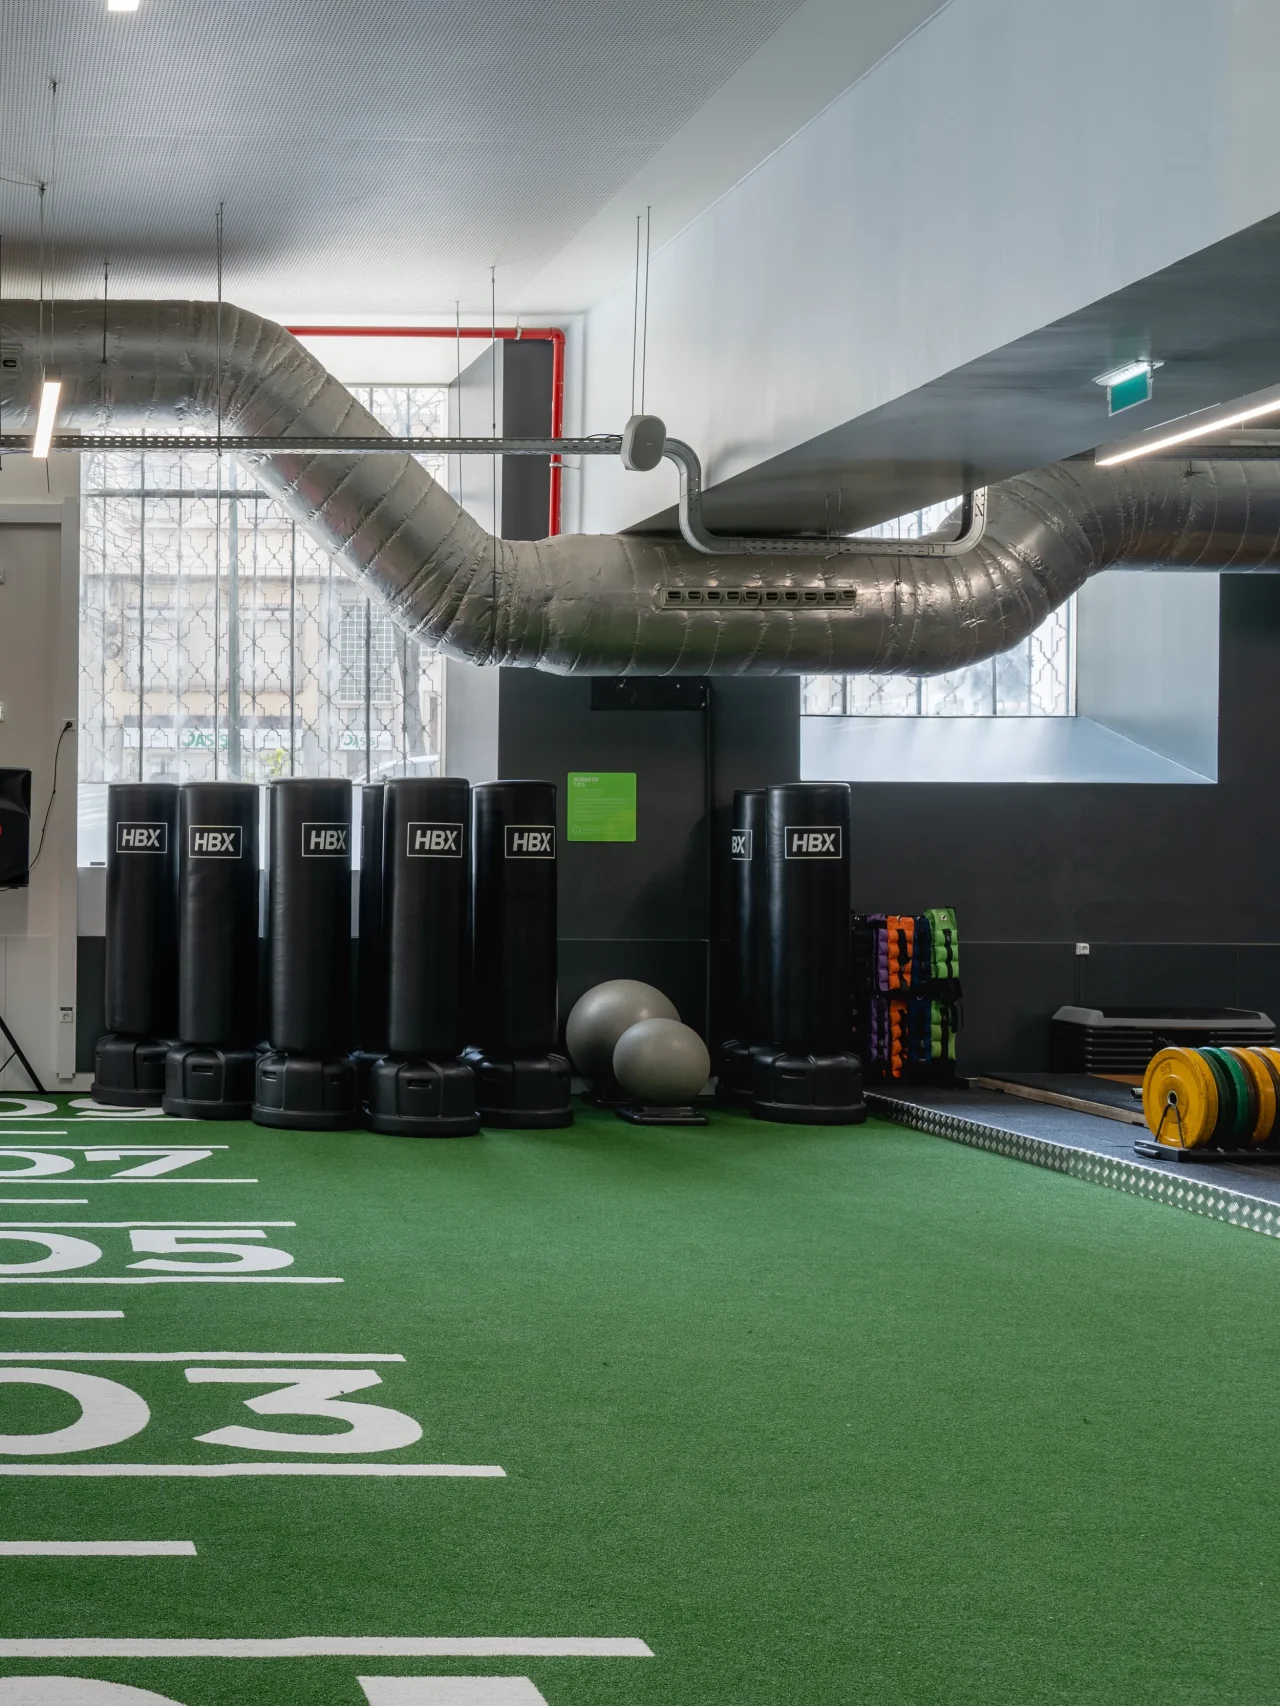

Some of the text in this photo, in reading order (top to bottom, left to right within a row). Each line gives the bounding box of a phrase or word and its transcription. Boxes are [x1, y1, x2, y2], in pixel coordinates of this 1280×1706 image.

[182, 730, 229, 748] OASS
[343, 734, 376, 747] OASS
[122, 829, 161, 847] HBX
[194, 833, 235, 852] HBX
[310, 830, 347, 850] HBX
[415, 830, 458, 850] HBX
[513, 833, 551, 851] HBX
[732, 836, 746, 853] BX
[792, 833, 836, 852] HBX
